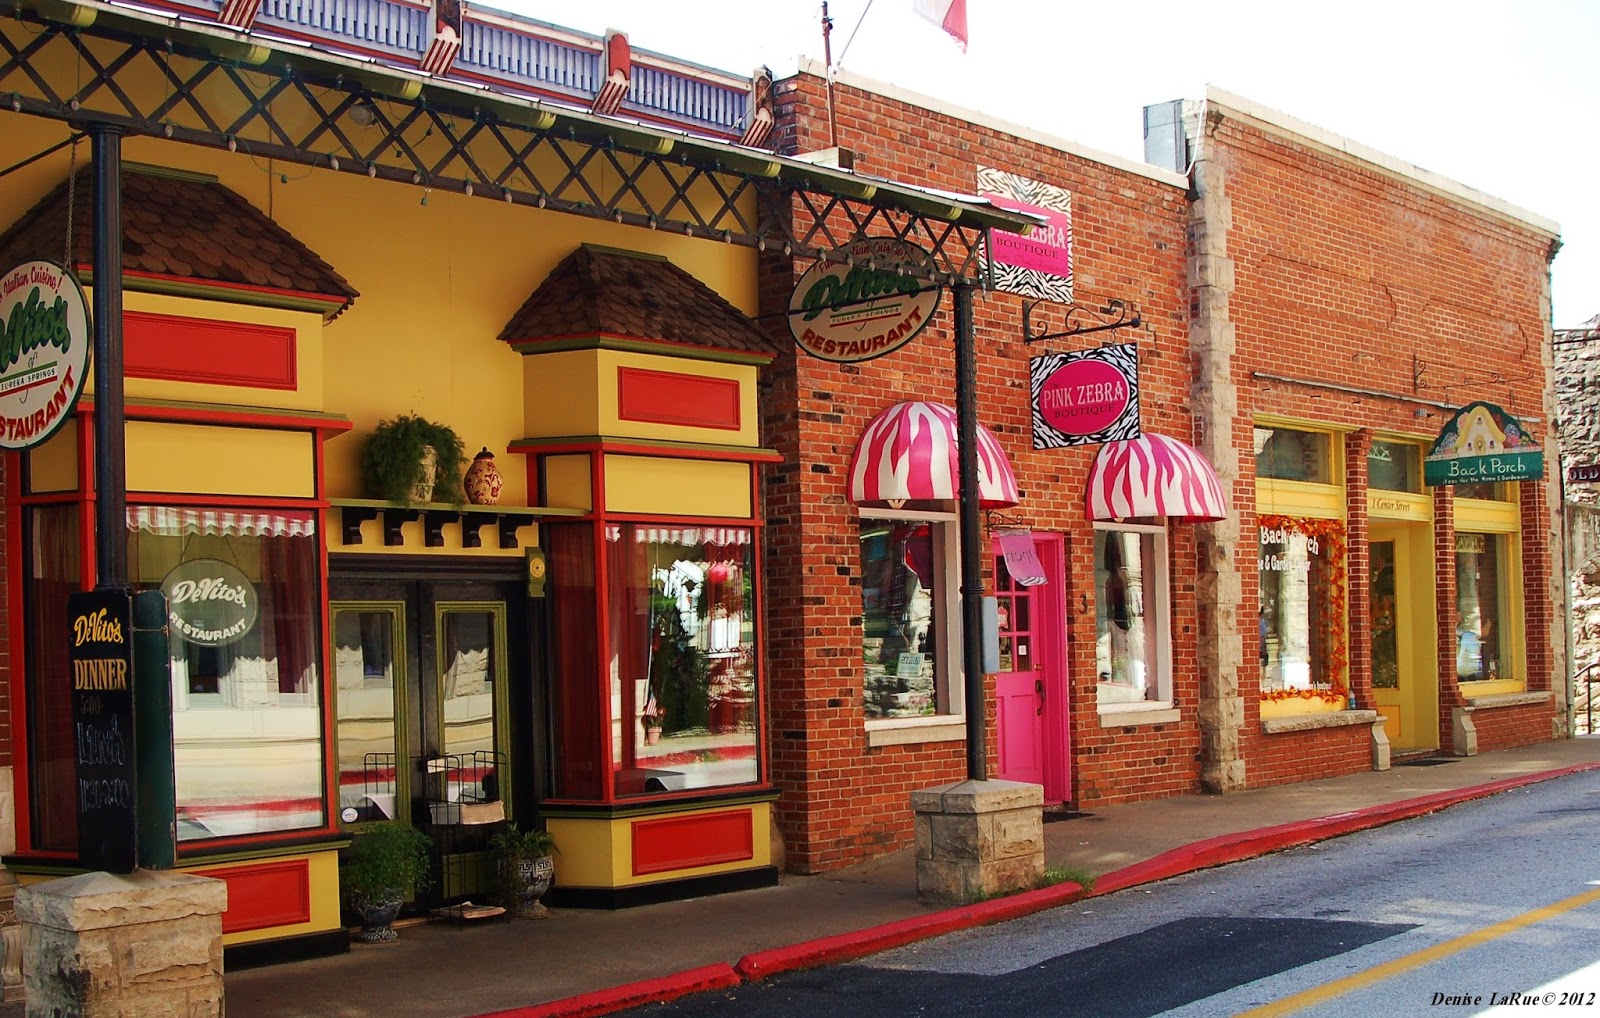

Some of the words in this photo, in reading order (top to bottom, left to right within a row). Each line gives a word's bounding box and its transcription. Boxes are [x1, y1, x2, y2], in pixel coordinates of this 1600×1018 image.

[996, 237, 1059, 259] BOUTIQUE
[1021, 225, 1067, 249] EBRA
[3, 272, 29, 297] Italian
[865, 308, 899, 318] SPRINGS
[0, 286, 71, 374] eVito's
[800, 305, 922, 356] RESTAURANT
[1, 378, 25, 391] EUREKA
[27, 367, 55, 383] SPRINGS
[0, 364, 74, 441] STAURANT
[1043, 387, 1075, 409] PINK
[1077, 381, 1125, 405] ZEBRA
[1055, 404, 1114, 419] BOUTIQUE
[1448, 460, 1488, 477] Back
[1490, 457, 1526, 474] Porch
[1376, 498, 1395, 510] Center
[1395, 500, 1410, 511] Street
[1264, 555, 1271, 571] &
[172, 577, 247, 608] DeVito's
[1079, 594, 1088, 615] 3
[74, 608, 124, 647] DeVito's
[169, 611, 247, 641] RESTAURANT
[73, 659, 128, 690] DINNER
